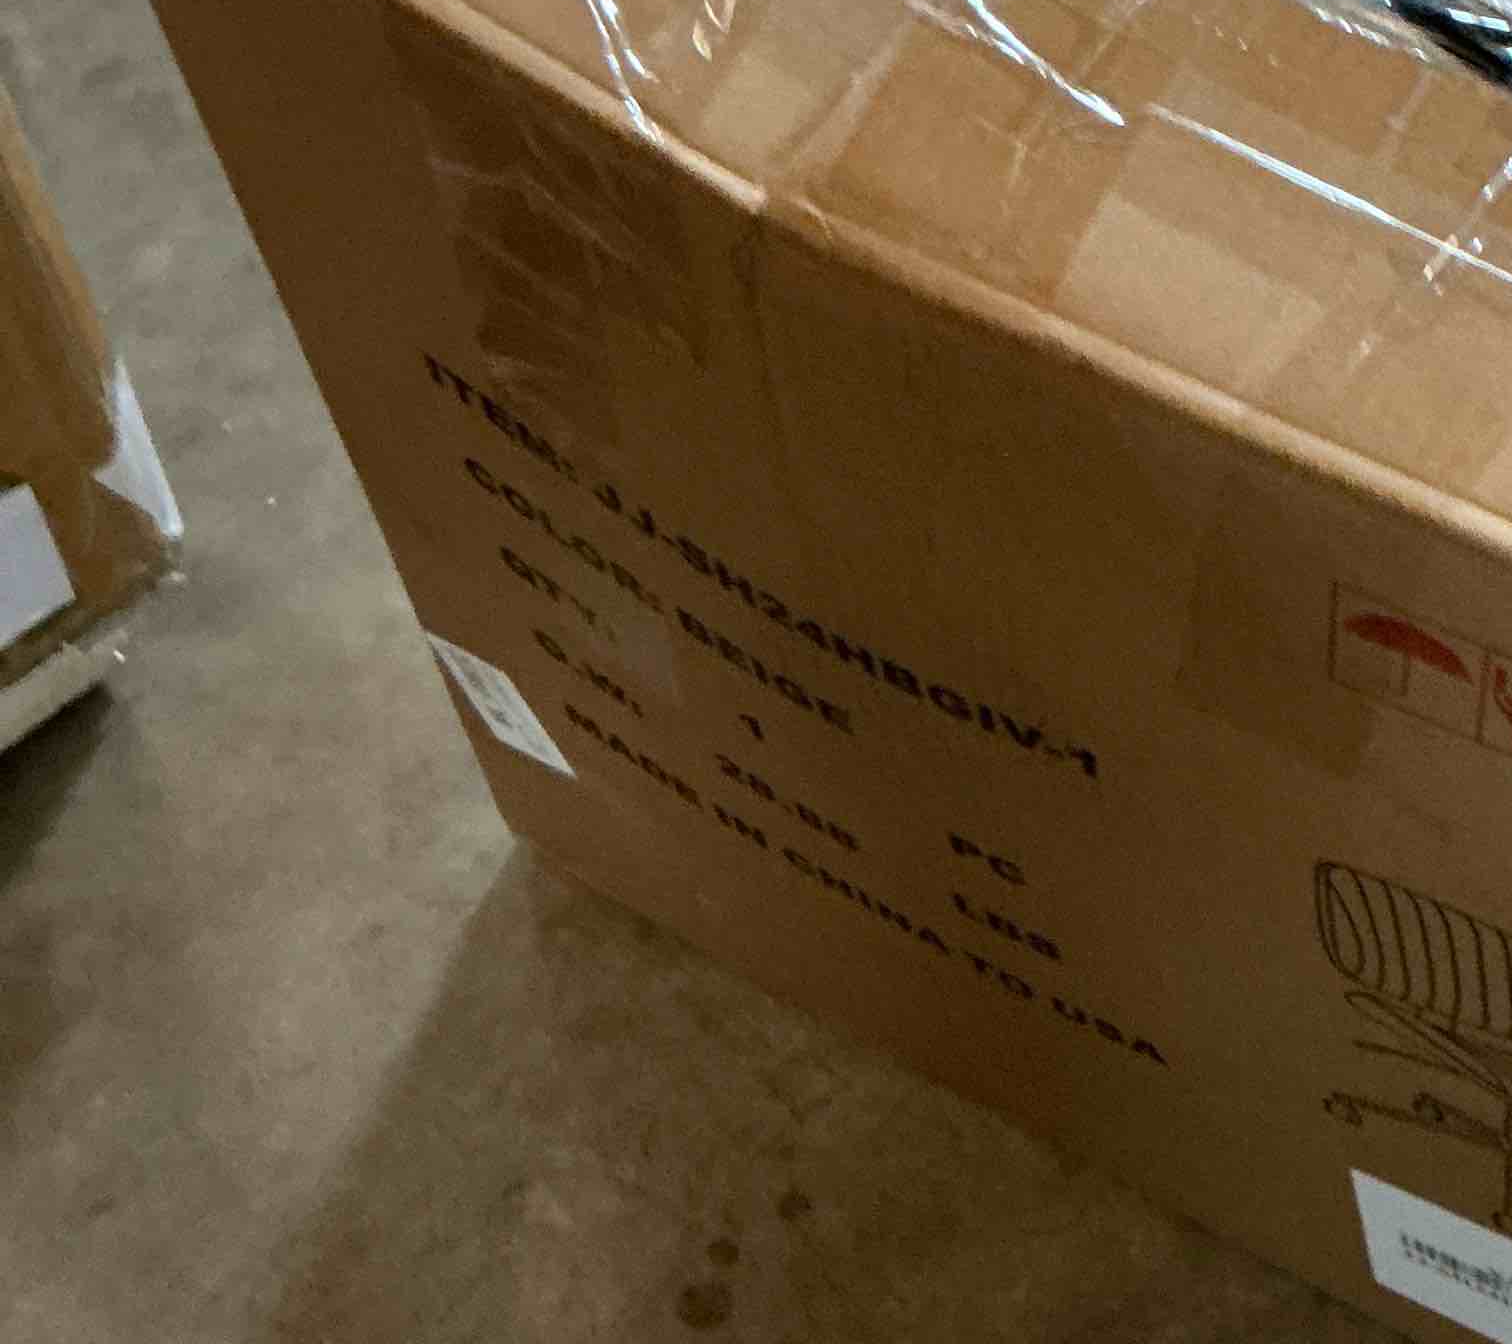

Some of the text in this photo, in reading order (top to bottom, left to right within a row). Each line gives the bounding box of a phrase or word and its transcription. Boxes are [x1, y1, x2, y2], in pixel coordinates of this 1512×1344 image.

[675, 606, 856, 736] BEIGE
[781, 847, 951, 955] CHINA
[1051, 996, 1170, 1066] USA
